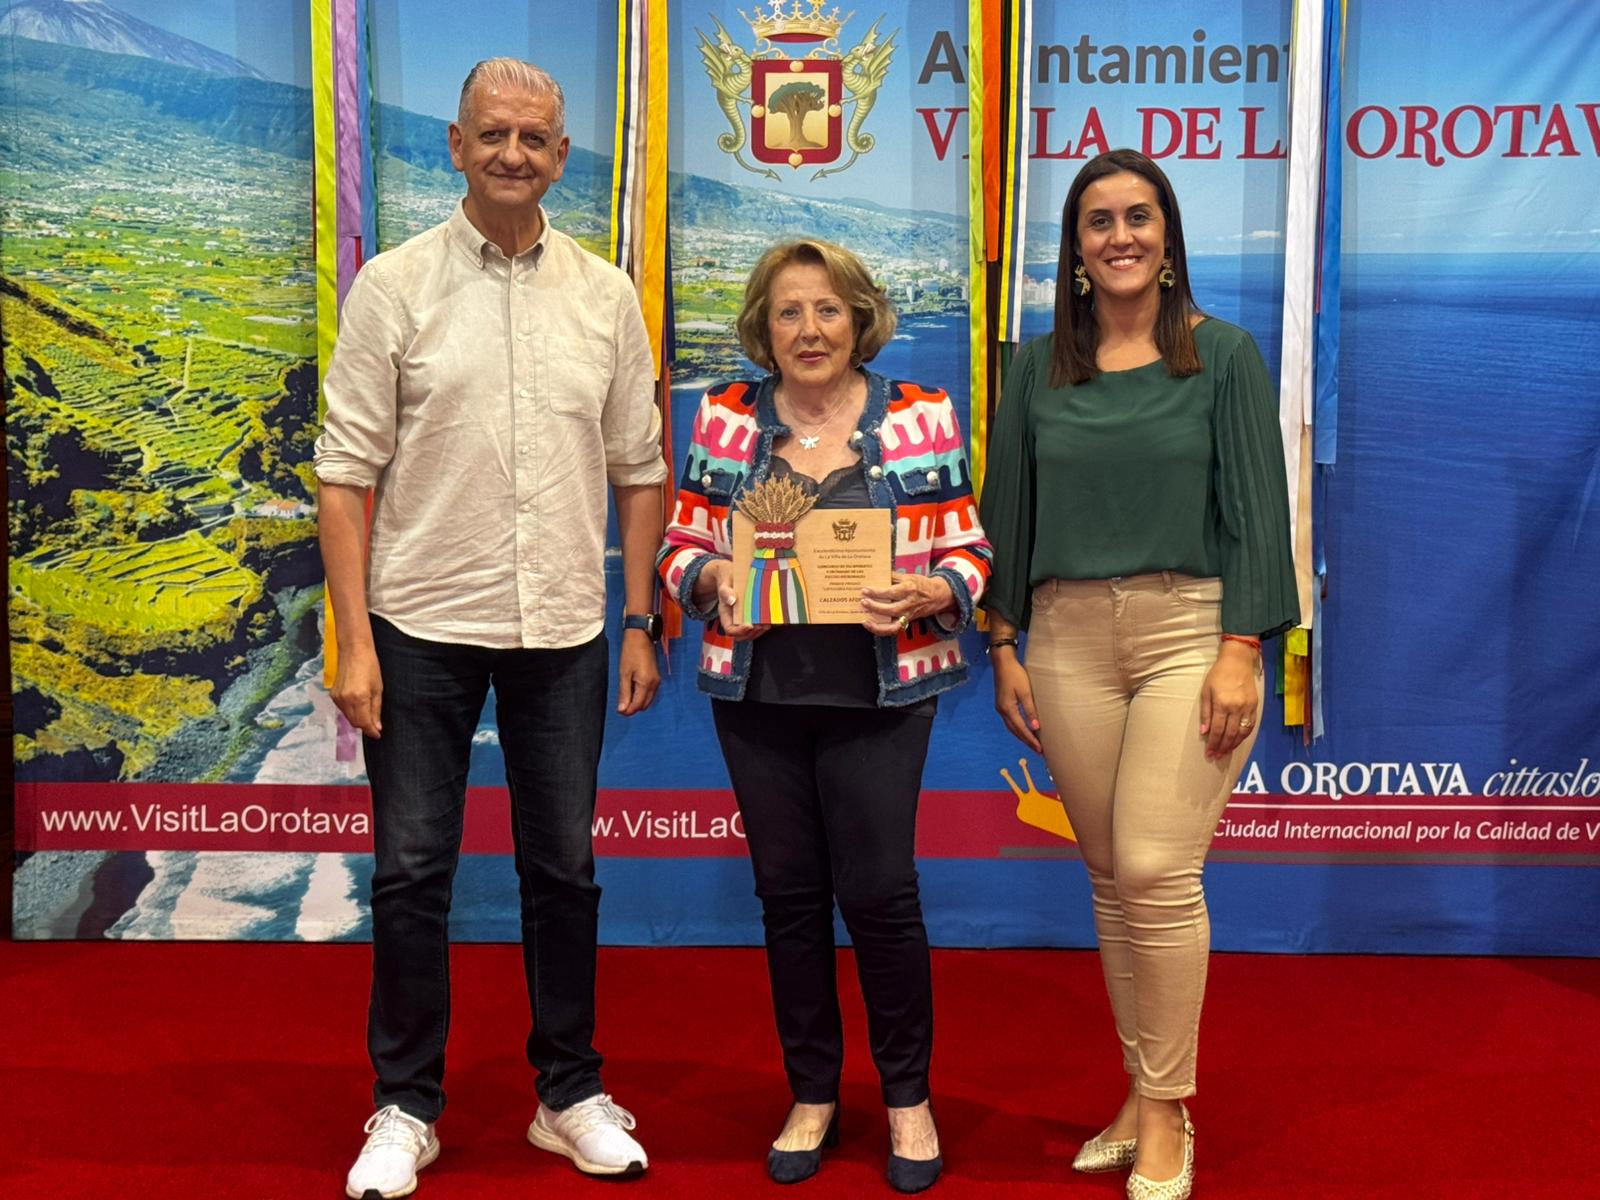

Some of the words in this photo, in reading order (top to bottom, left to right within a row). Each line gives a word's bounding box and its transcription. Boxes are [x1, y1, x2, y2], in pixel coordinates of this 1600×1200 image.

[916, 107, 1110, 160] VLA
[1136, 107, 1222, 160] DE
[1236, 107, 1288, 160] L
[1232, 761, 1269, 794] A
[1281, 761, 1472, 800] OROTAVA
[41, 804, 369, 834] www.VisitLaOrotava
[1214, 819, 1280, 838] Ciudad
[1284, 820, 1412, 840] Internacional
[1416, 825, 1450, 842] por
[1453, 821, 1471, 840] la
[1476, 821, 1552, 840] Calidad
[1556, 822, 1580, 840] de
